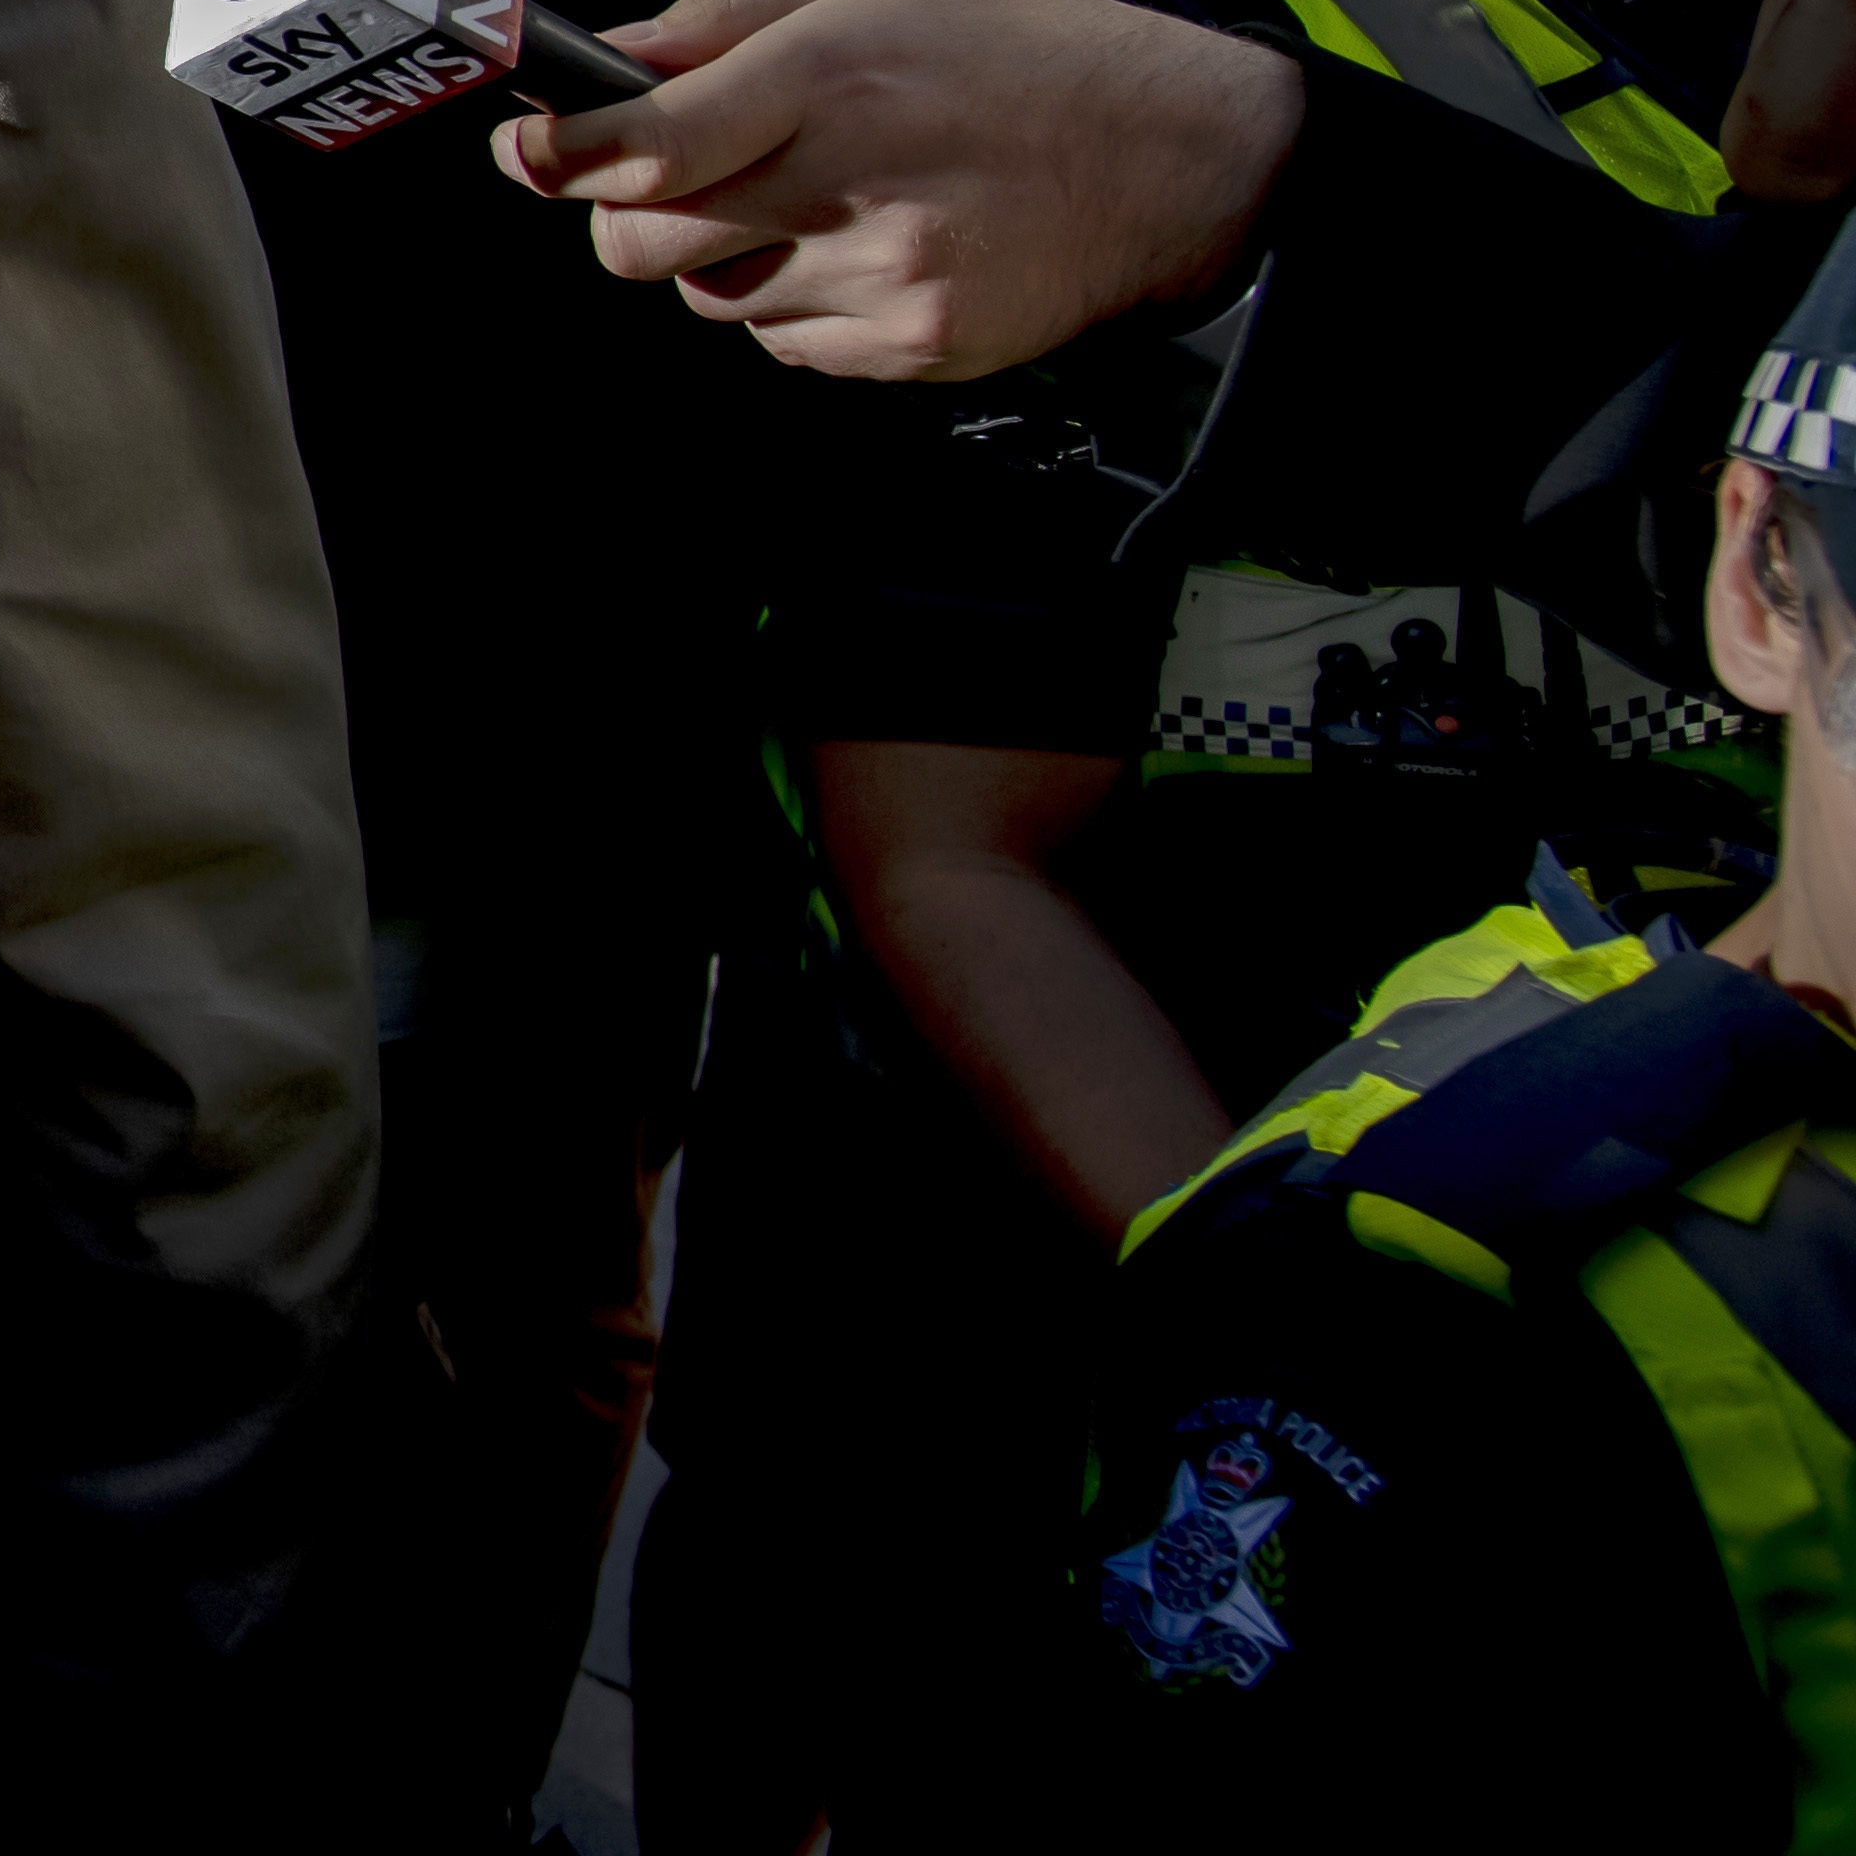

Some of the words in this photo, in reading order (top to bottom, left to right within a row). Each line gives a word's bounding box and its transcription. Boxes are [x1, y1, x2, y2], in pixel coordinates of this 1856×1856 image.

[275, 42, 485, 145] NEWS
[1392, 762, 1478, 777] OTOROLA
[1274, 1410, 1384, 1504] POLICE
